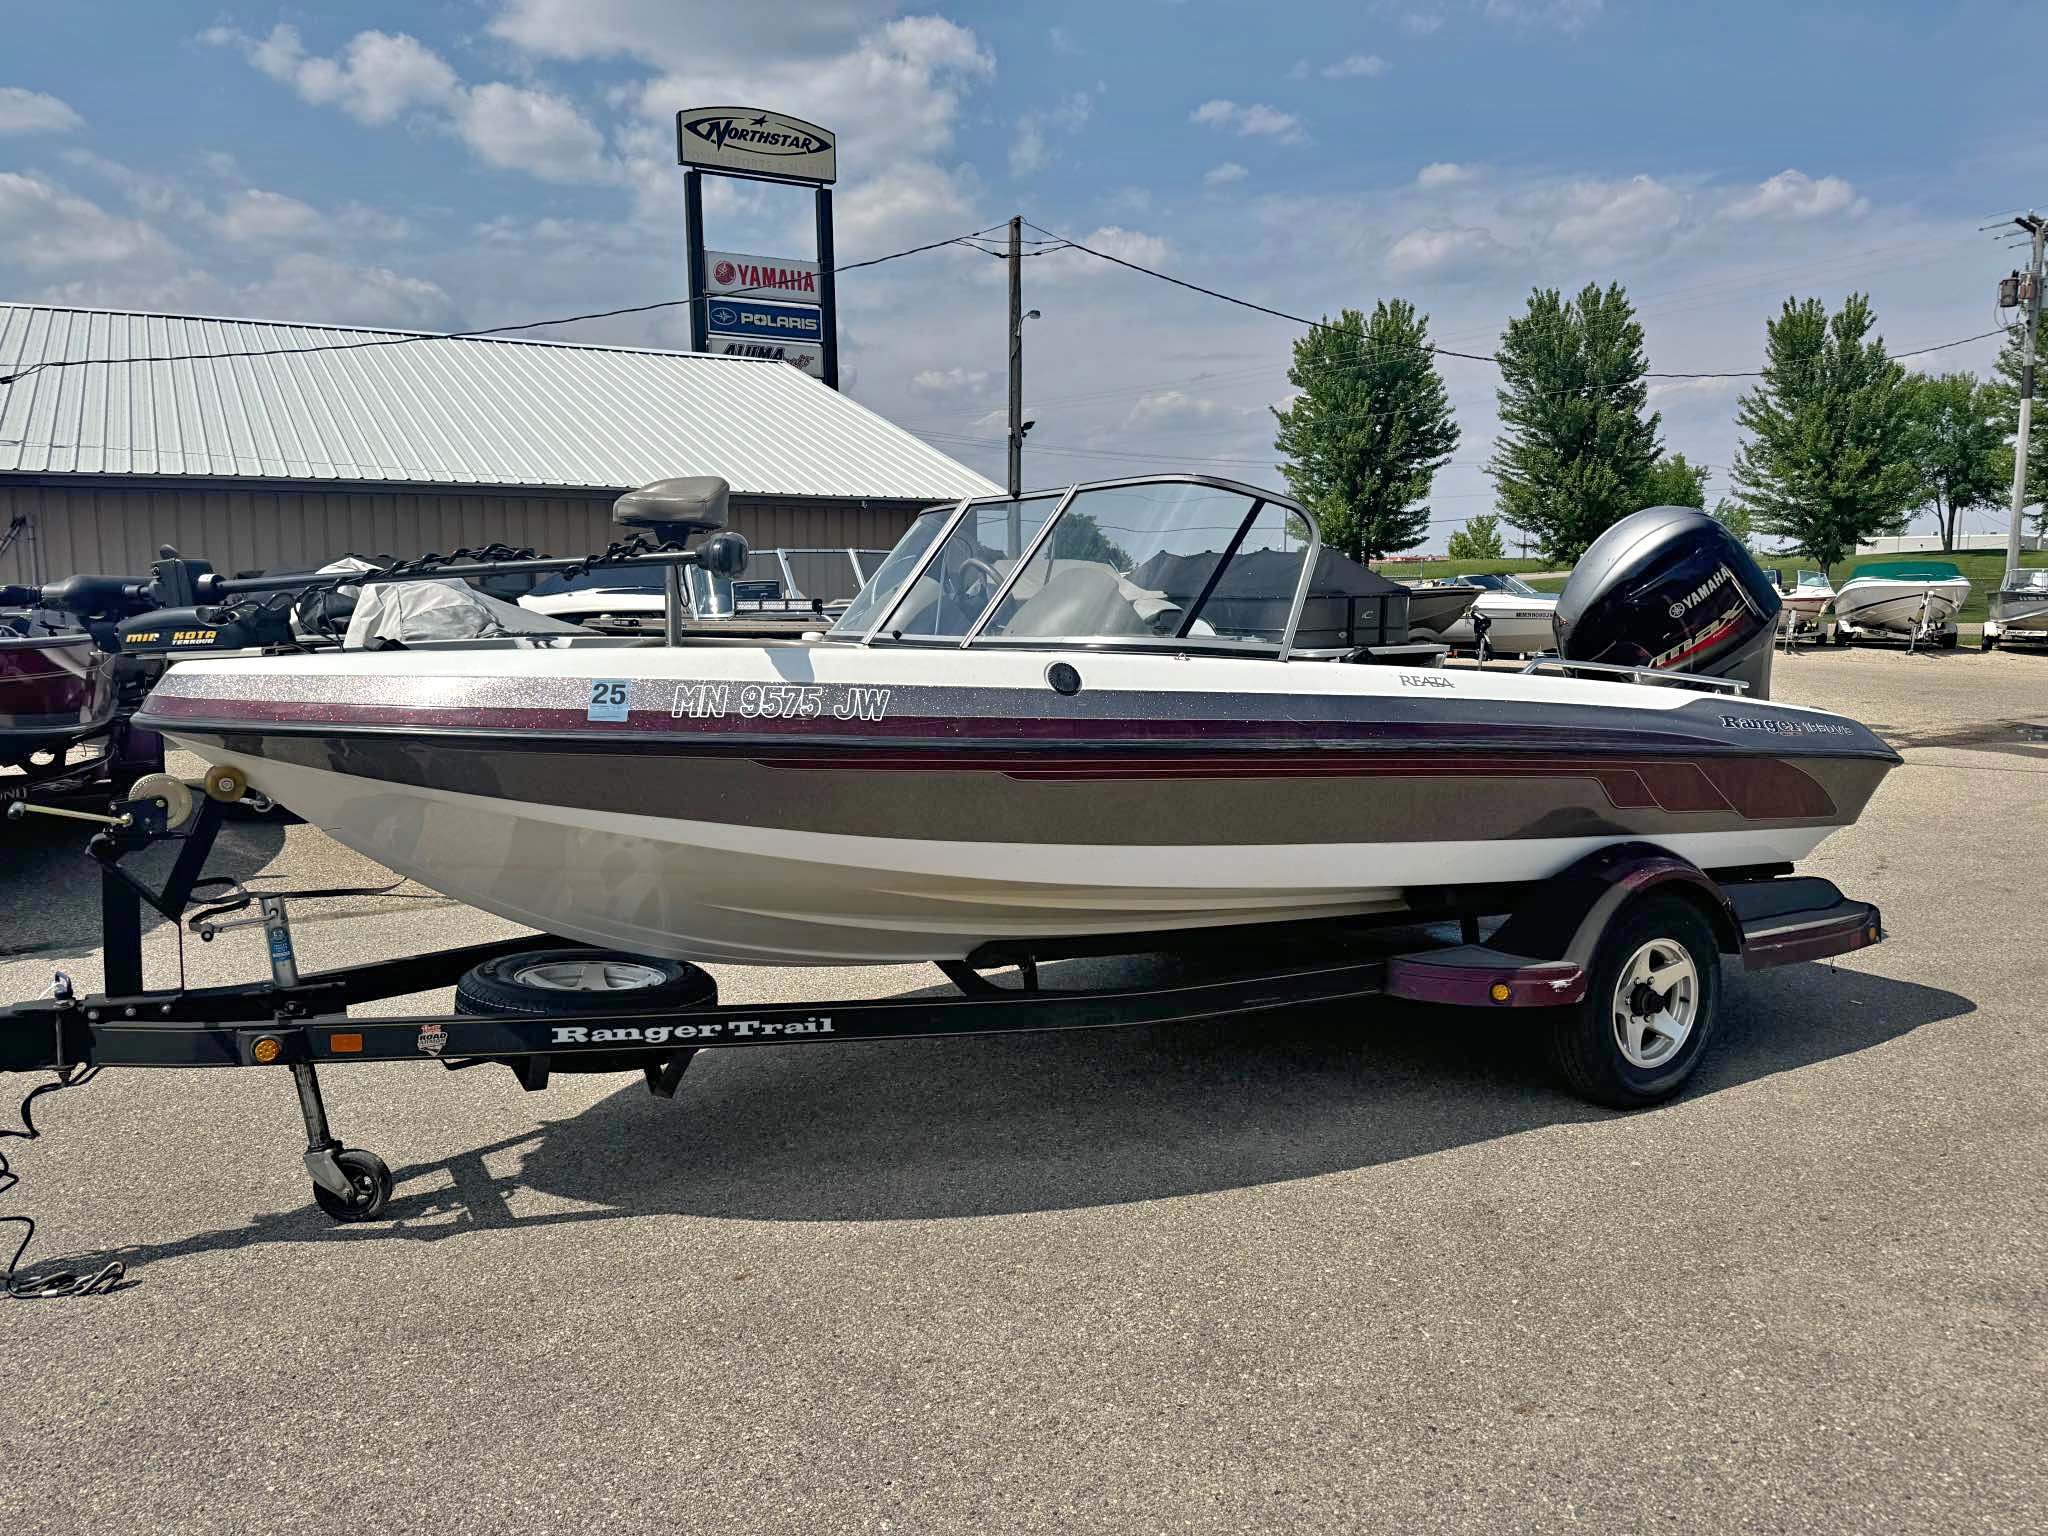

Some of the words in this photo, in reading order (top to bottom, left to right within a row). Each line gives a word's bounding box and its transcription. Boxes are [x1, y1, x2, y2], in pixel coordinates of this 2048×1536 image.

[705, 120, 813, 152] NORTHSTAR
[738, 264, 815, 292] YAMAHA
[740, 312, 818, 330] POLARIS
[1682, 566, 1732, 609] YAMAHA
[173, 631, 218, 640] KOTA
[1398, 675, 1456, 688] REATA
[591, 683, 626, 705] 25
[671, 684, 728, 718] MN
[740, 685, 822, 718] 9575
[833, 687, 890, 721] JW
[1718, 714, 1801, 734] Ranger
